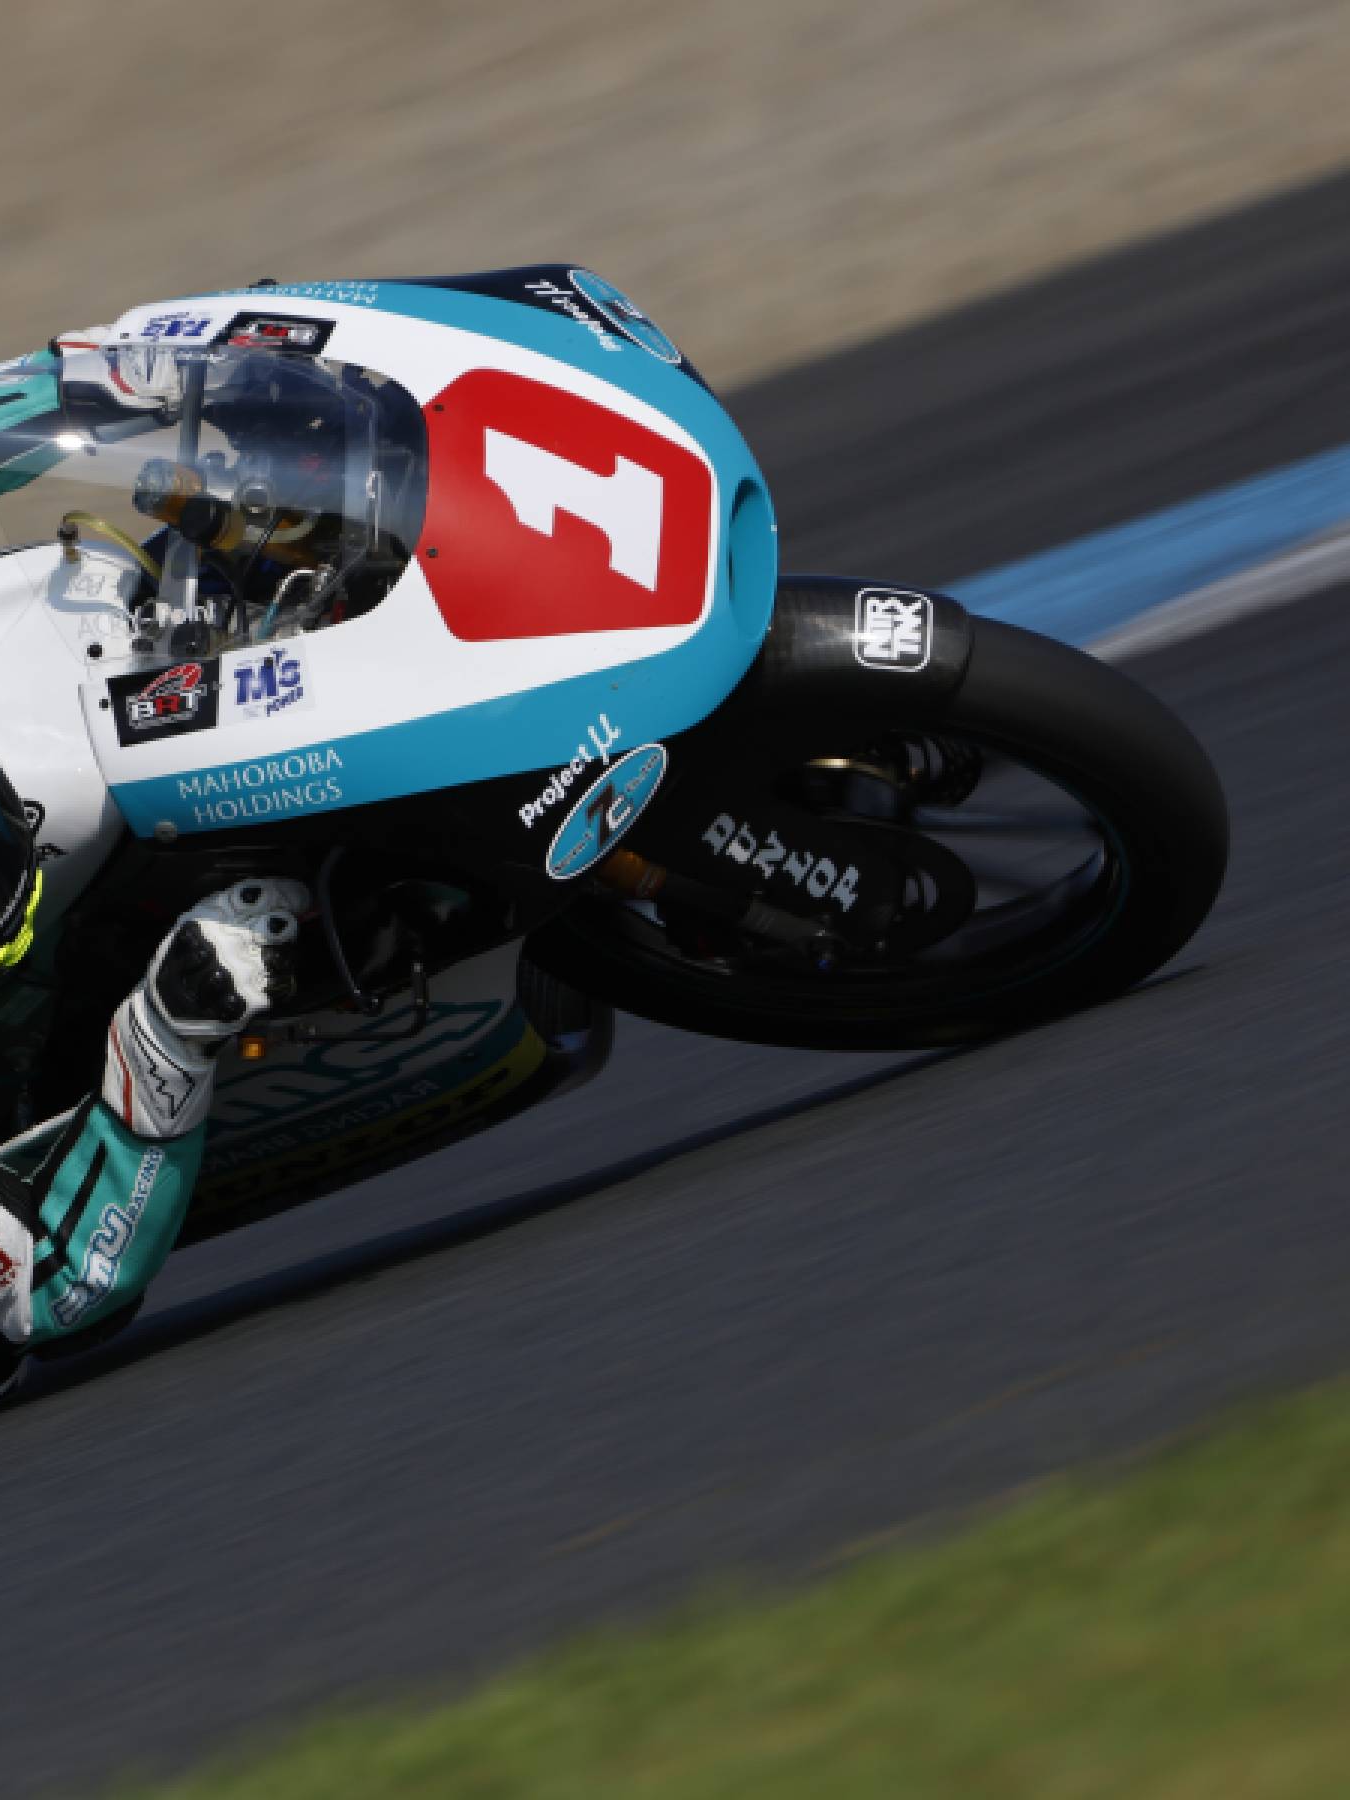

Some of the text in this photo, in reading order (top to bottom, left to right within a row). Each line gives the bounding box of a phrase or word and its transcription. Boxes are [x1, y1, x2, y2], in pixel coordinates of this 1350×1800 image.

[483, 426, 664, 592] 1
[176, 747, 344, 800] MAHOROBA
[193, 778, 342, 826] HOLDINGS
[518, 744, 593, 829] Project
[700, 812, 859, 912] DUNLOP
